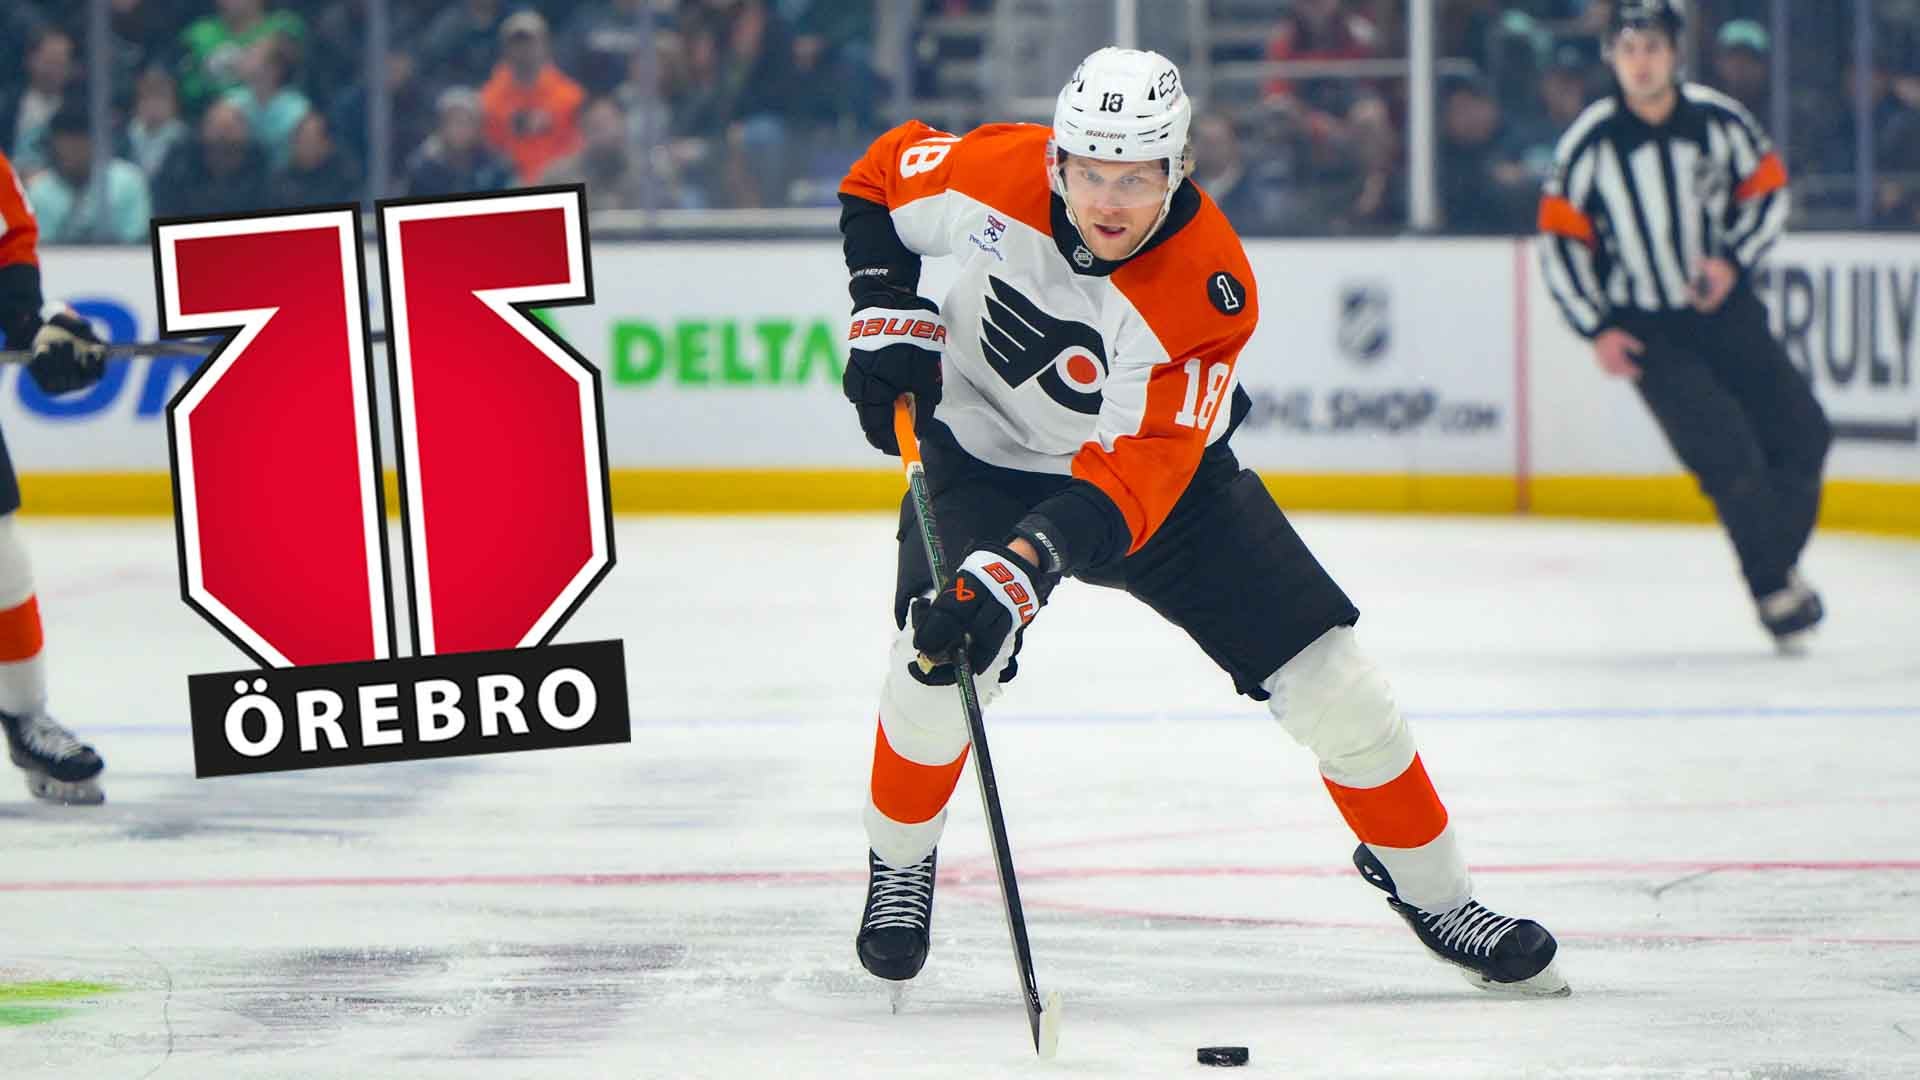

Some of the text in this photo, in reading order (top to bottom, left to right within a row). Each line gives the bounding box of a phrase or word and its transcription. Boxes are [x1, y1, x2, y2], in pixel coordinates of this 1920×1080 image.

[1099, 92, 1124, 113] 18
[1216, 274, 1239, 310] 1
[611, 318, 848, 385] DELTA
[1175, 357, 1230, 430] 18
